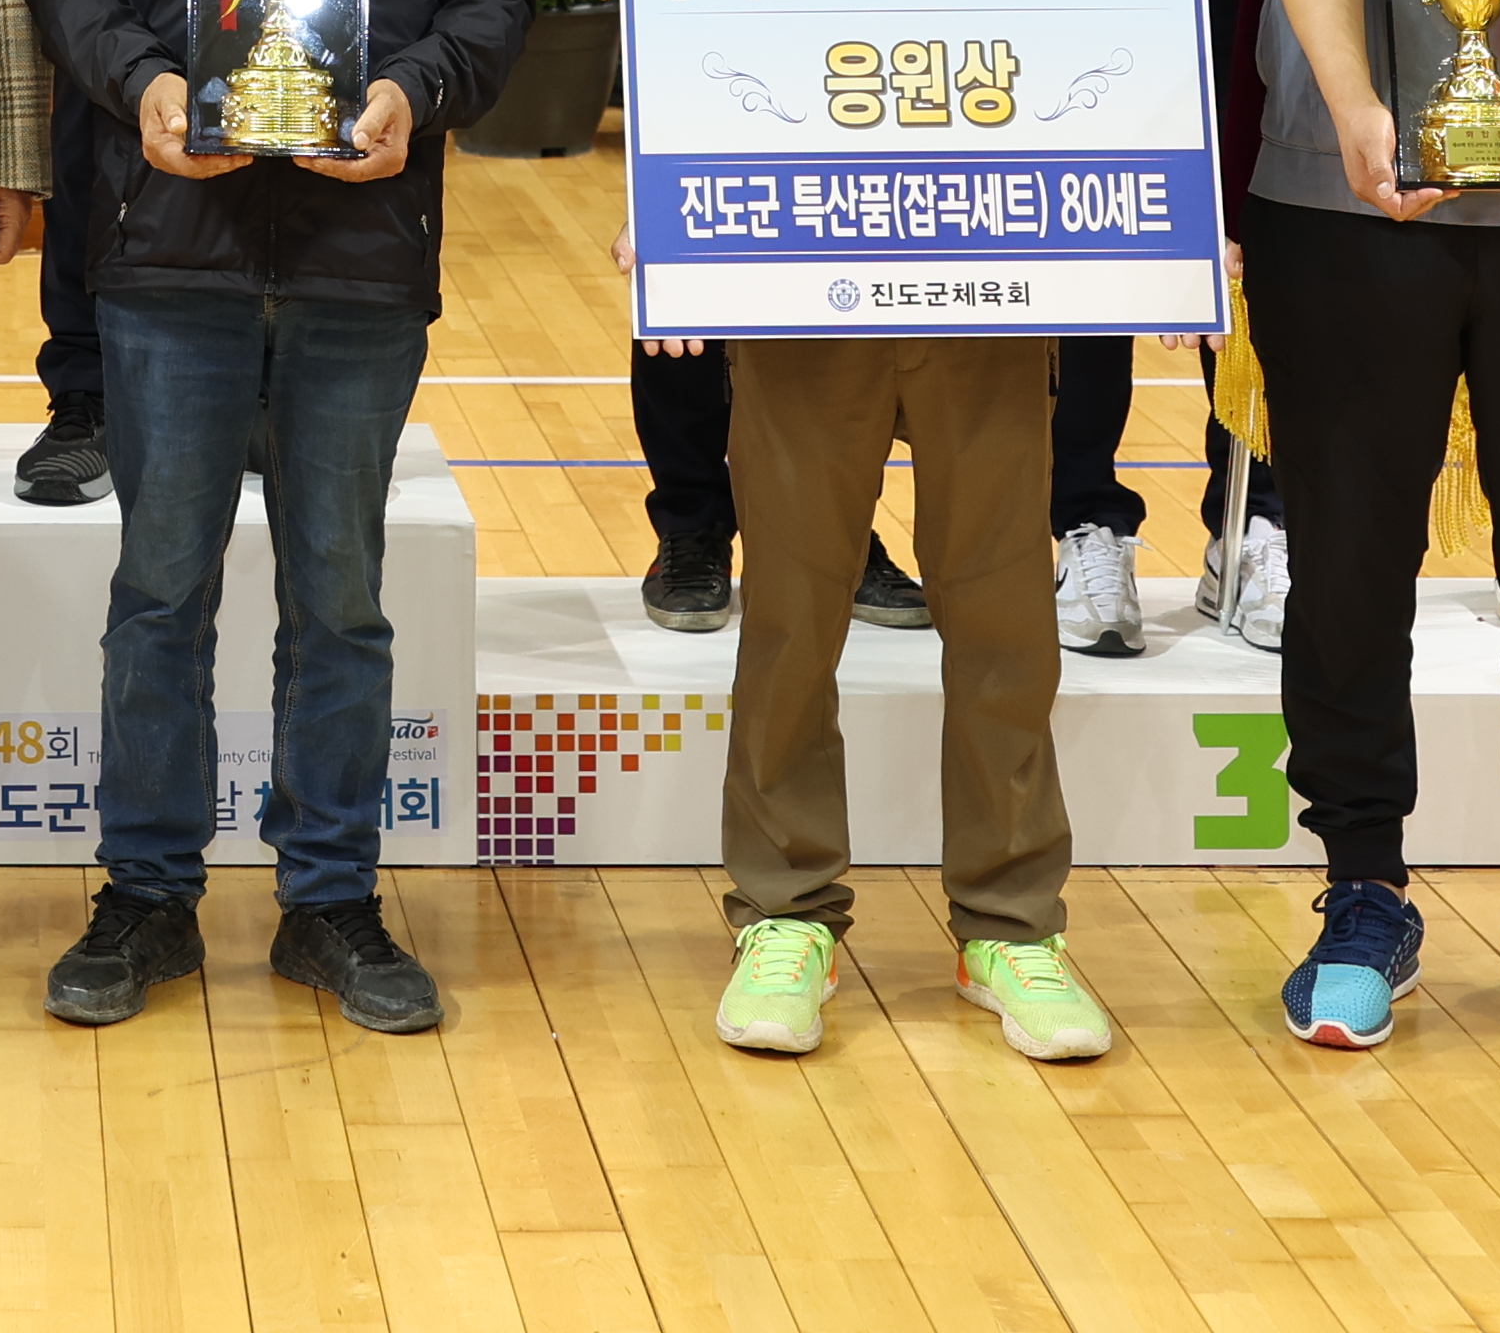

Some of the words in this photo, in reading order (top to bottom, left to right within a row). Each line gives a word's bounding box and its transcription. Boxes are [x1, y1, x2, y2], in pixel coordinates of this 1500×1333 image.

[823, 40, 1019, 128] 응원상
[680, 176, 780, 239] 진도군
[792, 171, 1049, 239] 특산품(잡곡세트)
[1061, 172, 1172, 233] 80세트
[870, 281, 1031, 308] 진도군체육회
[1193, 712, 1290, 850] 3
